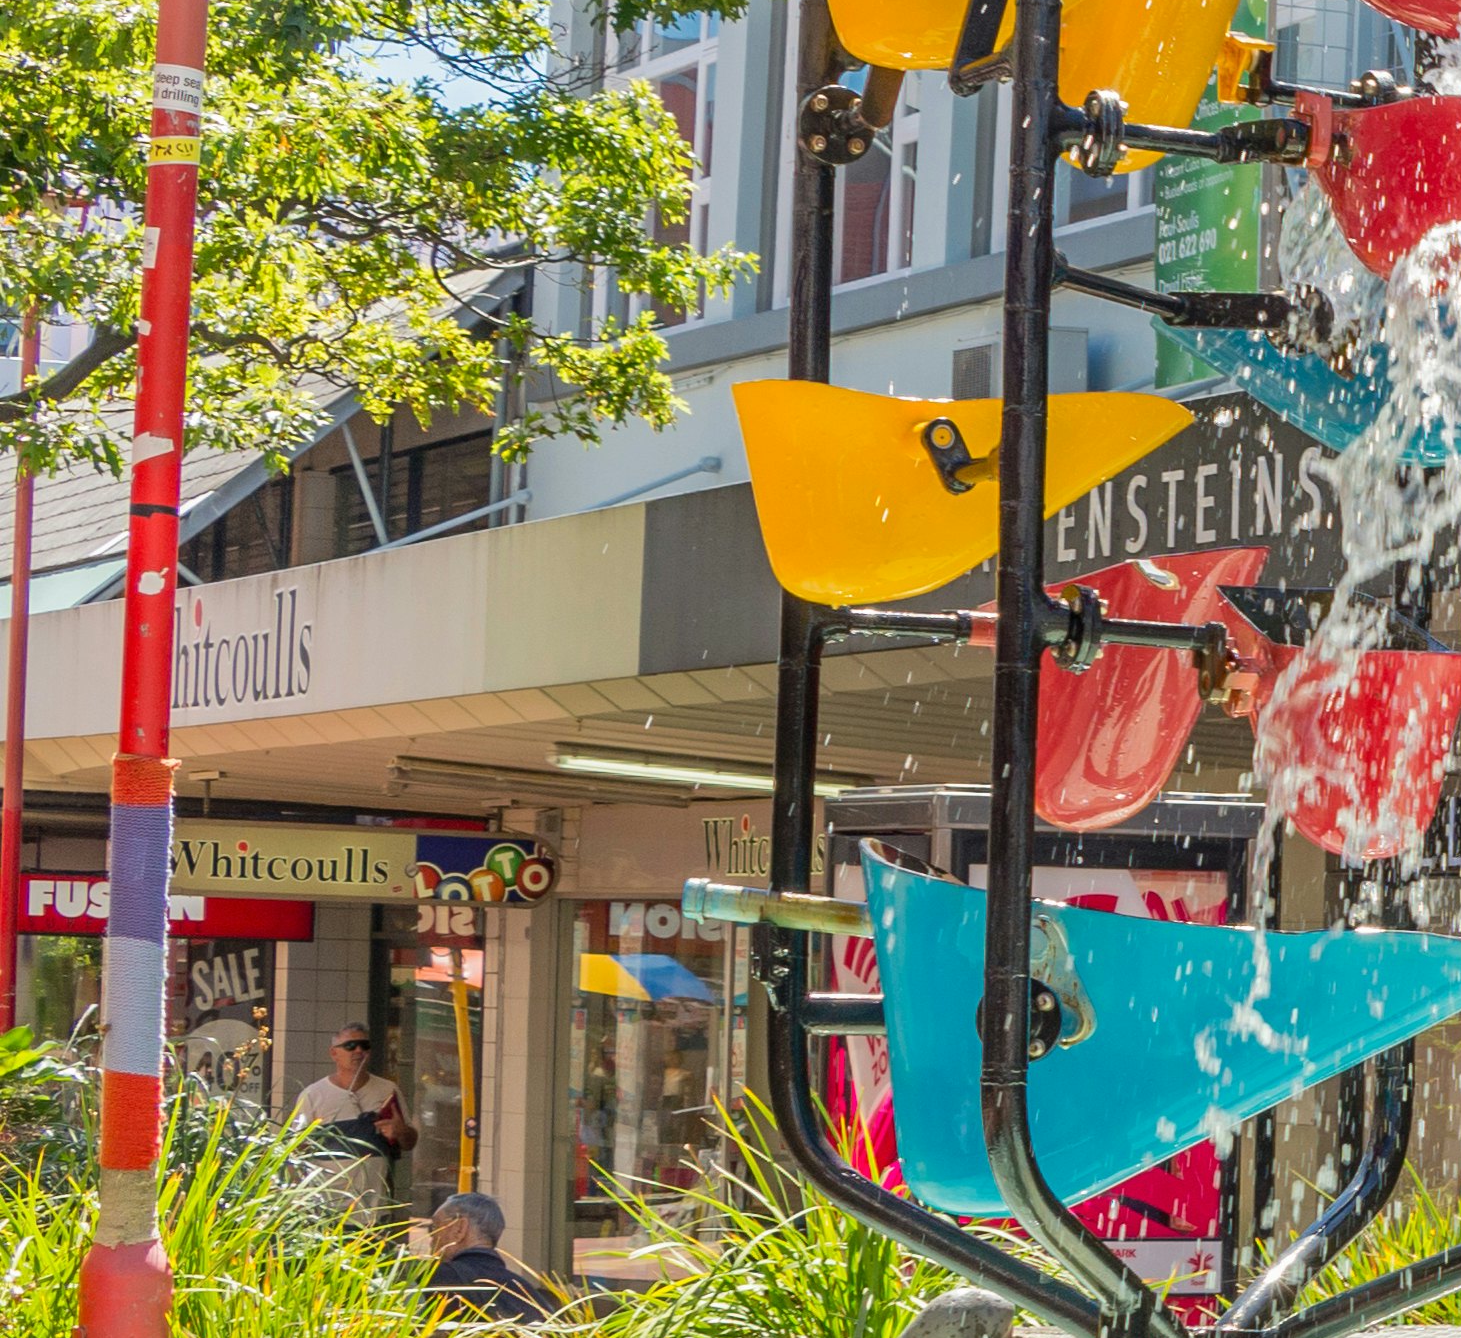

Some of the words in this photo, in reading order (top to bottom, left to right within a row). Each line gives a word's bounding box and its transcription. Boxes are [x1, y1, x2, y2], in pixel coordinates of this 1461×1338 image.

[161, 87, 200, 108] drilling
[1158, 242, 1177, 266] 021
[1178, 234, 1198, 259] 622
[1199, 227, 1218, 253] 690
[172, 588, 313, 709] hitcoulls
[170, 839, 389, 885] Whitcoulls
[703, 813, 826, 878] Whitcls
[414, 849, 552, 901] LOTTO
[27, 879, 206, 922] FUSN
[191, 947, 266, 1011] SALE
[240, 1082, 261, 1095] OFF
